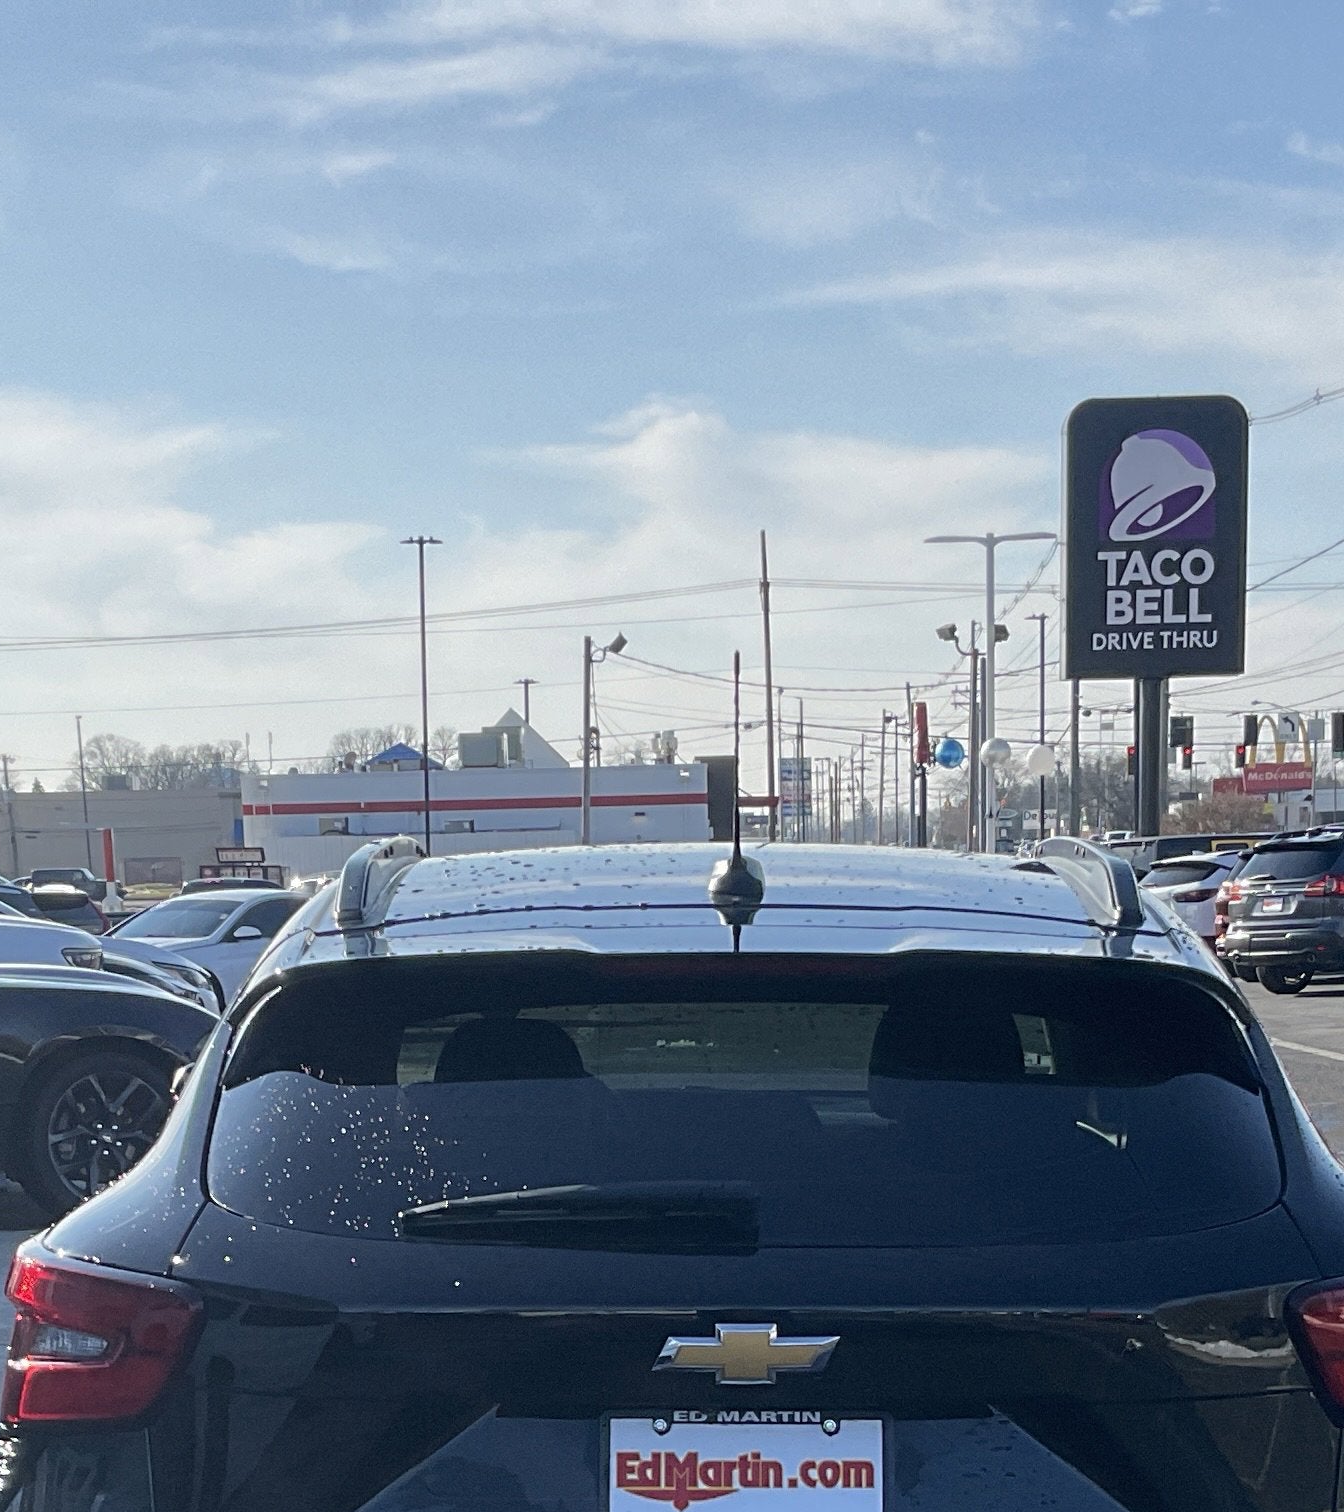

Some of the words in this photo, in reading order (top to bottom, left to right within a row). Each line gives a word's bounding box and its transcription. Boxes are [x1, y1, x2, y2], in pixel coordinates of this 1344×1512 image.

[1097, 548, 1215, 586] TACO
[1106, 588, 1212, 625] BELL
[1092, 631, 1154, 651] DRIVE
[1159, 630, 1218, 649] THRU
[1247, 771, 1313, 781] McDonald's
[672, 1410, 707, 1423] ED
[716, 1410, 822, 1423] MARTIN
